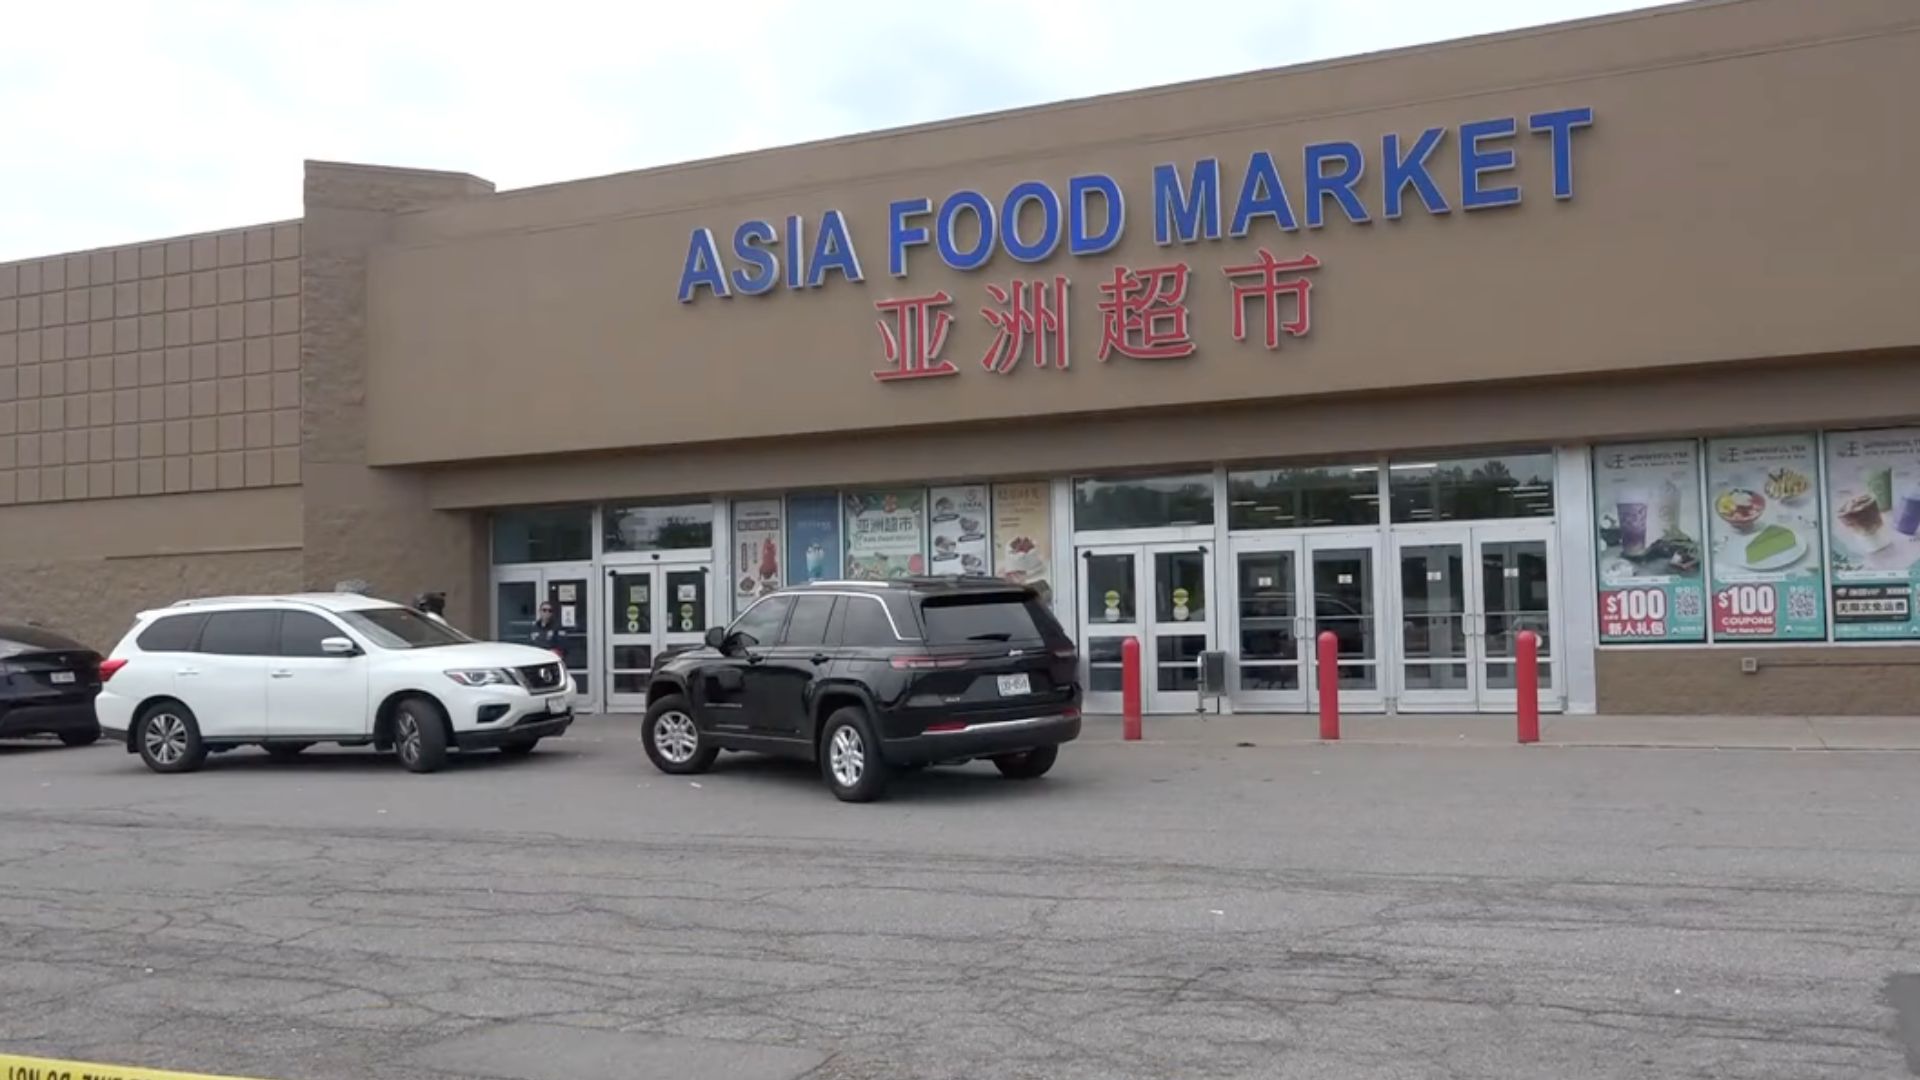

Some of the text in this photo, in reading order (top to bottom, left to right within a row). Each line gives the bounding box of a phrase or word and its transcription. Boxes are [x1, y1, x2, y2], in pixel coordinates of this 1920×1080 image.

[678, 108, 1594, 304] ASIA FOOD MARKET
[872, 250, 1321, 382] 亚洲超市
[856, 516, 913, 533] 亚洲超市
[1606, 590, 1665, 620] $100
[1718, 586, 1774, 615] $100
[1608, 621, 1665, 636] 新人礼包
[1721, 615, 1774, 626] COUPONS
